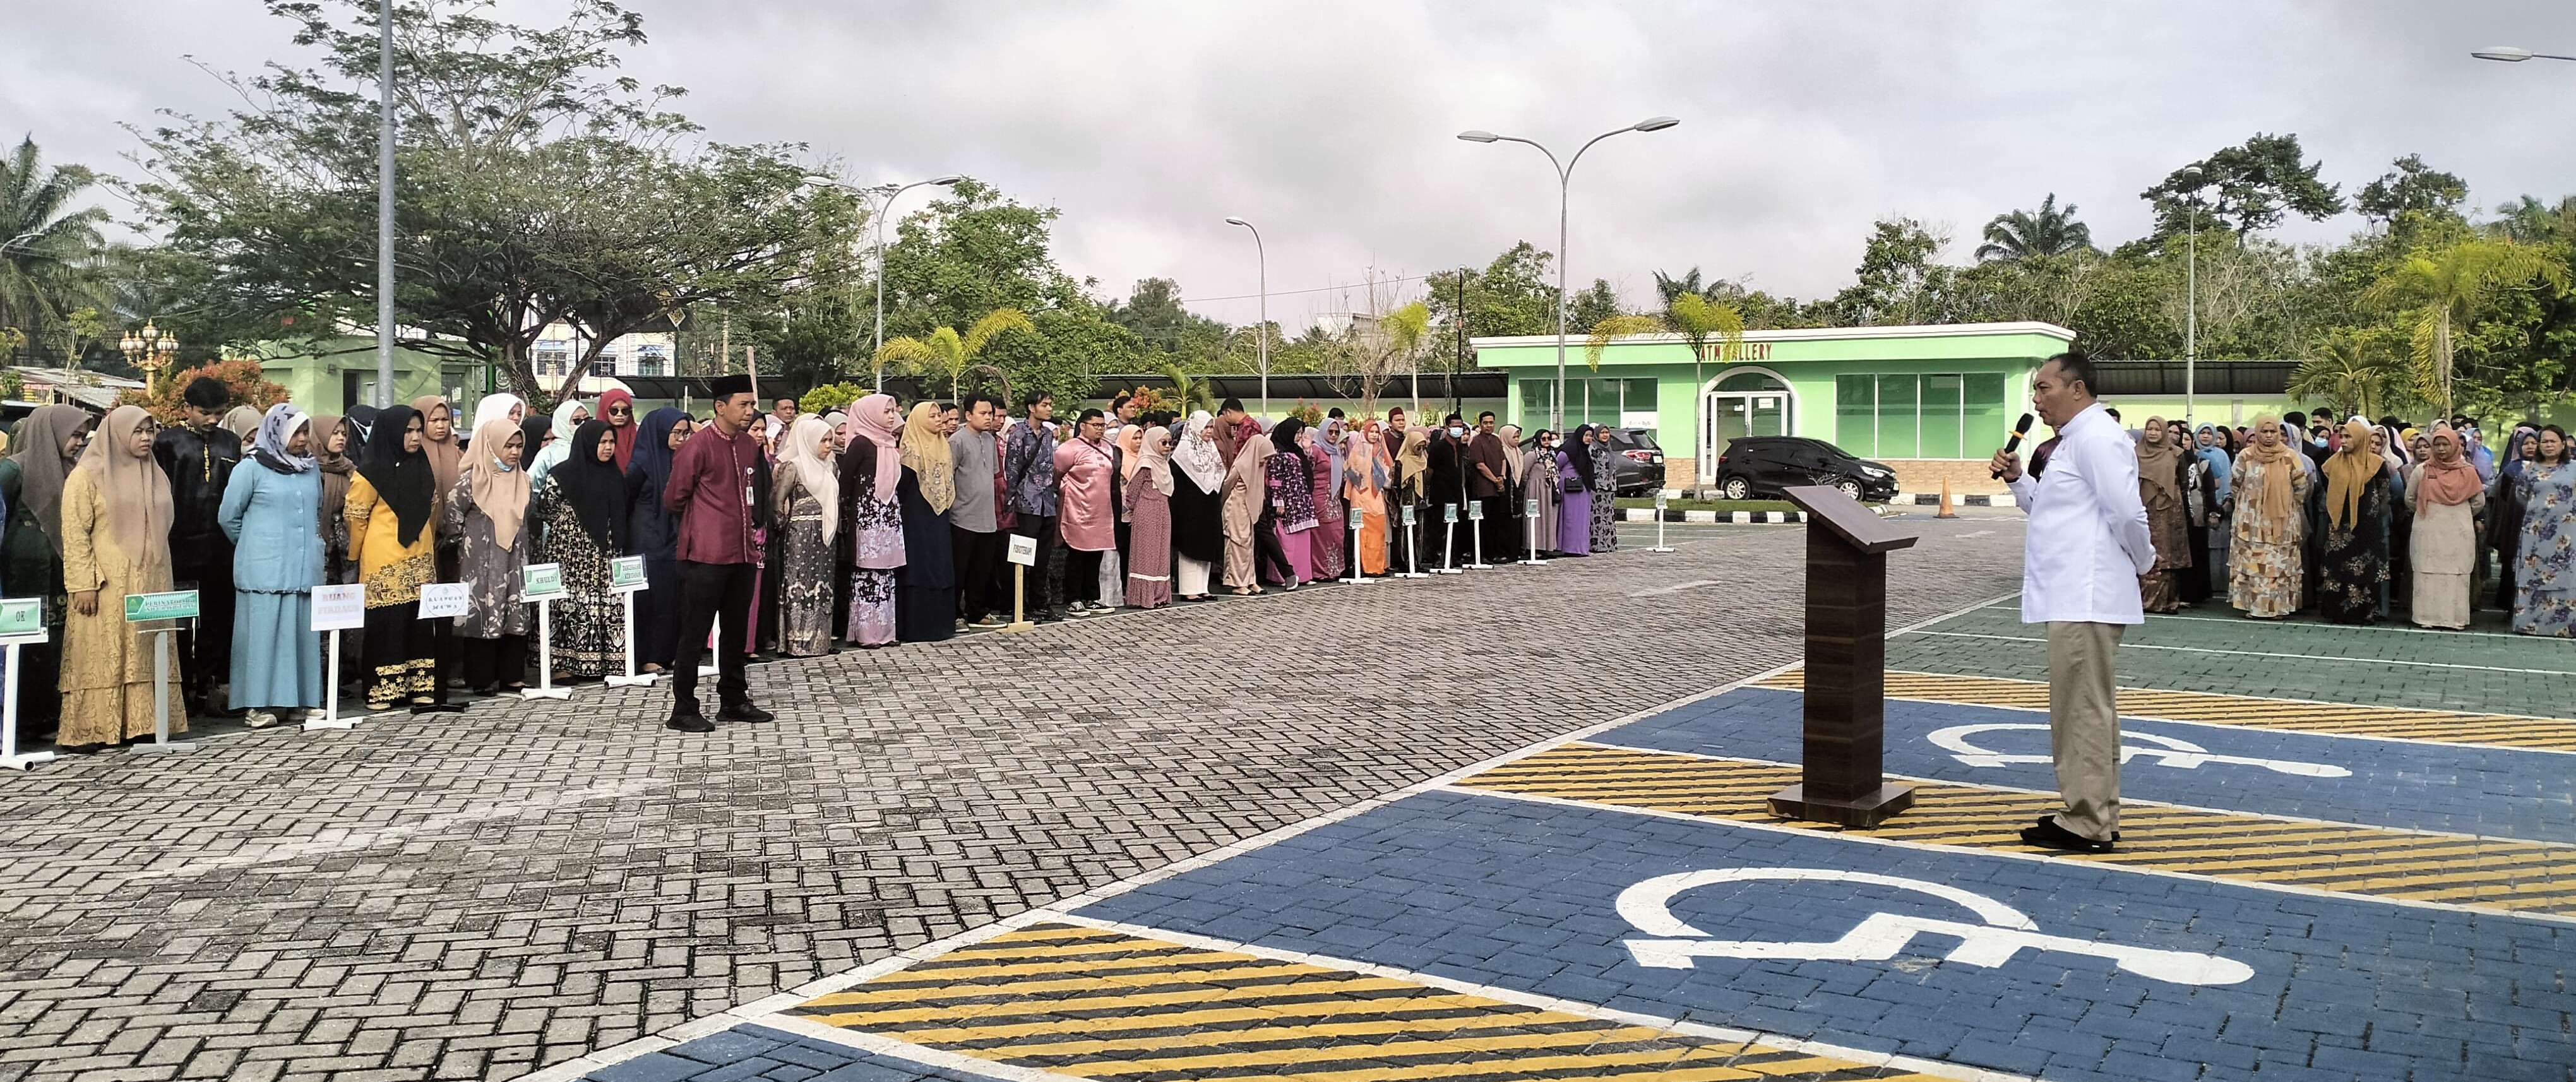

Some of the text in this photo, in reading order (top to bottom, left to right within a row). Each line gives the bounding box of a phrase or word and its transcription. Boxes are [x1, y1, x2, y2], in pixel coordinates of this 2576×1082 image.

[1701, 343, 1772, 361] ATM ALLERY
[536, 576, 557, 584] KHULDI
[323, 593, 355, 602] RUANG
[16, 610, 25, 622] OK
